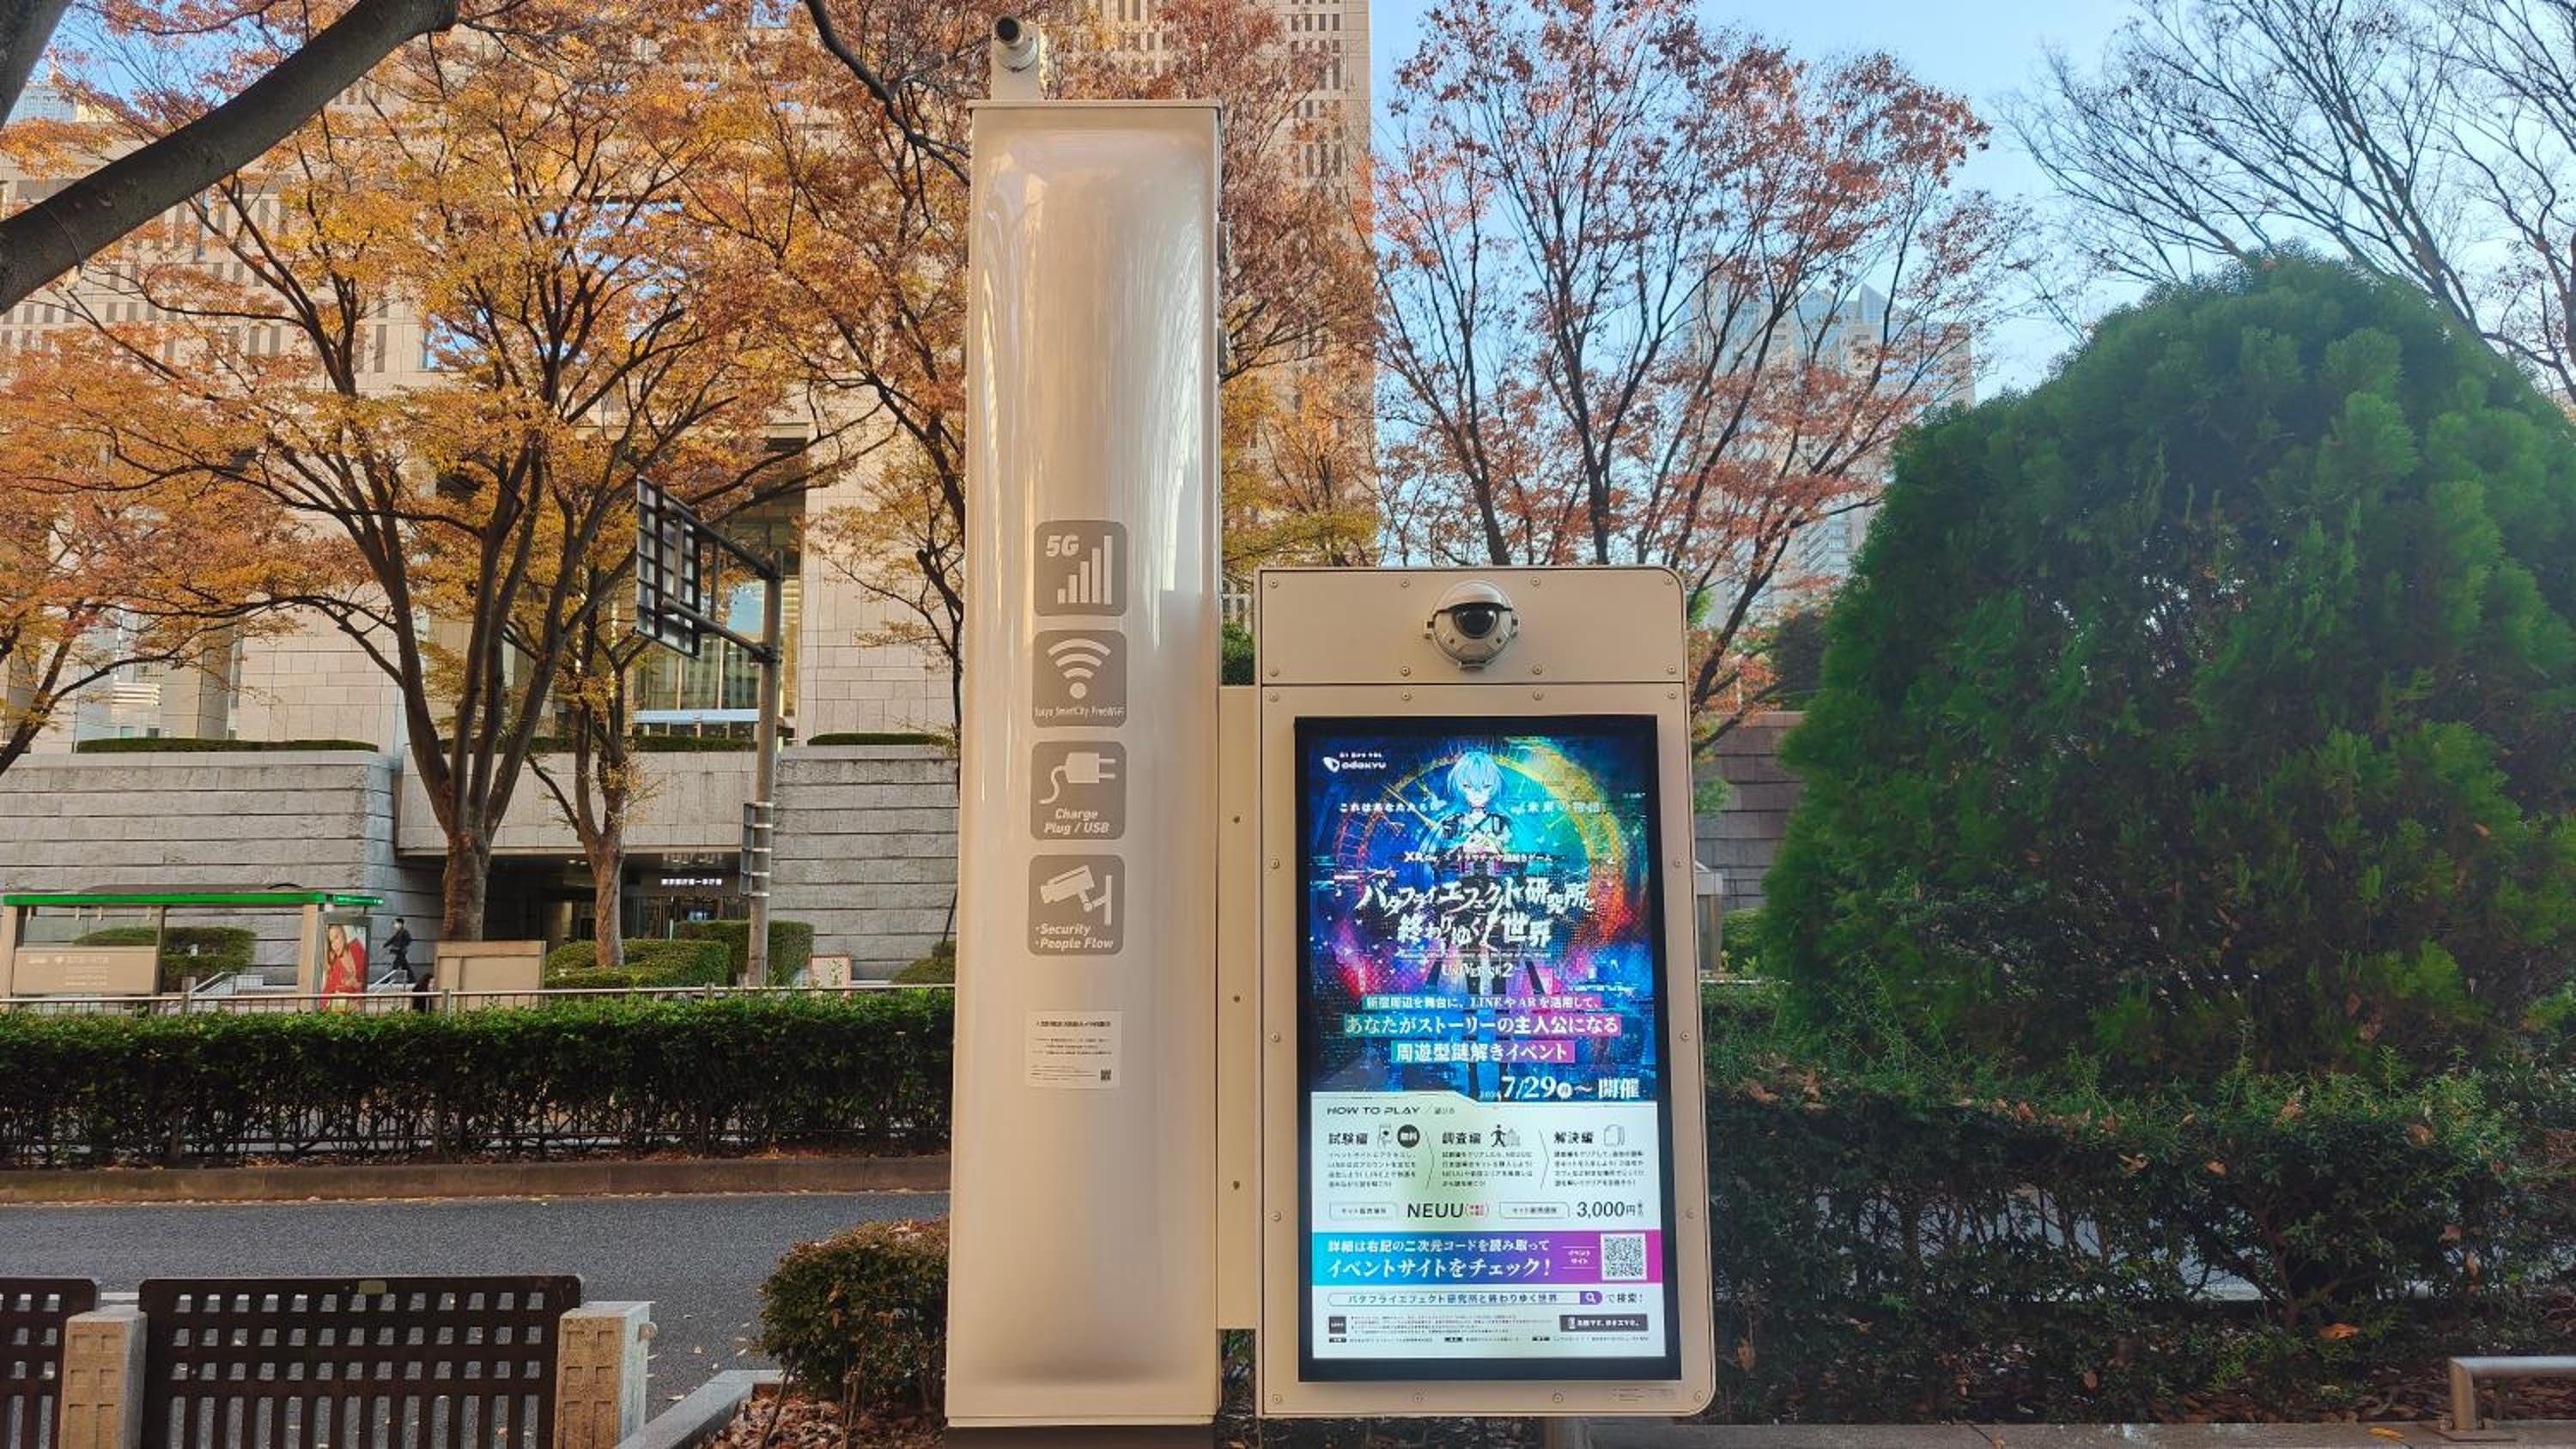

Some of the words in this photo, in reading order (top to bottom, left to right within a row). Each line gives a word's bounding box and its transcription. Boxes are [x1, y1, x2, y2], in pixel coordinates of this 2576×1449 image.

[1045, 534, 1079, 558] 5G
[1341, 761, 1387, 770] odakyu
[1055, 808, 1098, 822] Charge
[1044, 822, 1071, 835] Plug
[1084, 822, 1110, 834] USB
[1354, 876, 1595, 916] バタフライエフェクト研究所と
[1039, 923, 1091, 937] Security
[1396, 912, 1552, 949] 終わりゆく世界
[1039, 937, 1081, 951] People
[1084, 938, 1114, 949] Flow
[1503, 963, 1514, 977] 2
[1346, 1016, 1619, 1034] あなたがストーリーの主人公になる
[1395, 1043, 1569, 1063] 周遊型謎解きイベント
[1598, 1077, 1641, 1098] 開催
[1327, 1106, 1359, 1115] HOW
[1327, 1131, 1369, 1145] 試験編
[1442, 1131, 1482, 1145] 調査編
[1553, 1131, 1595, 1144] 解決編
[1406, 1203, 1464, 1218] NEUU
[1577, 1201, 1636, 1219] 3,000円
[1327, 1239, 1550, 1253] 詳細は右記の二次元コードを読み取って
[1327, 1258, 1551, 1278] イベントサイトをチェック！
[1348, 1293, 1558, 1305] バタフライエフェクト研究所と終わりゆく世界
